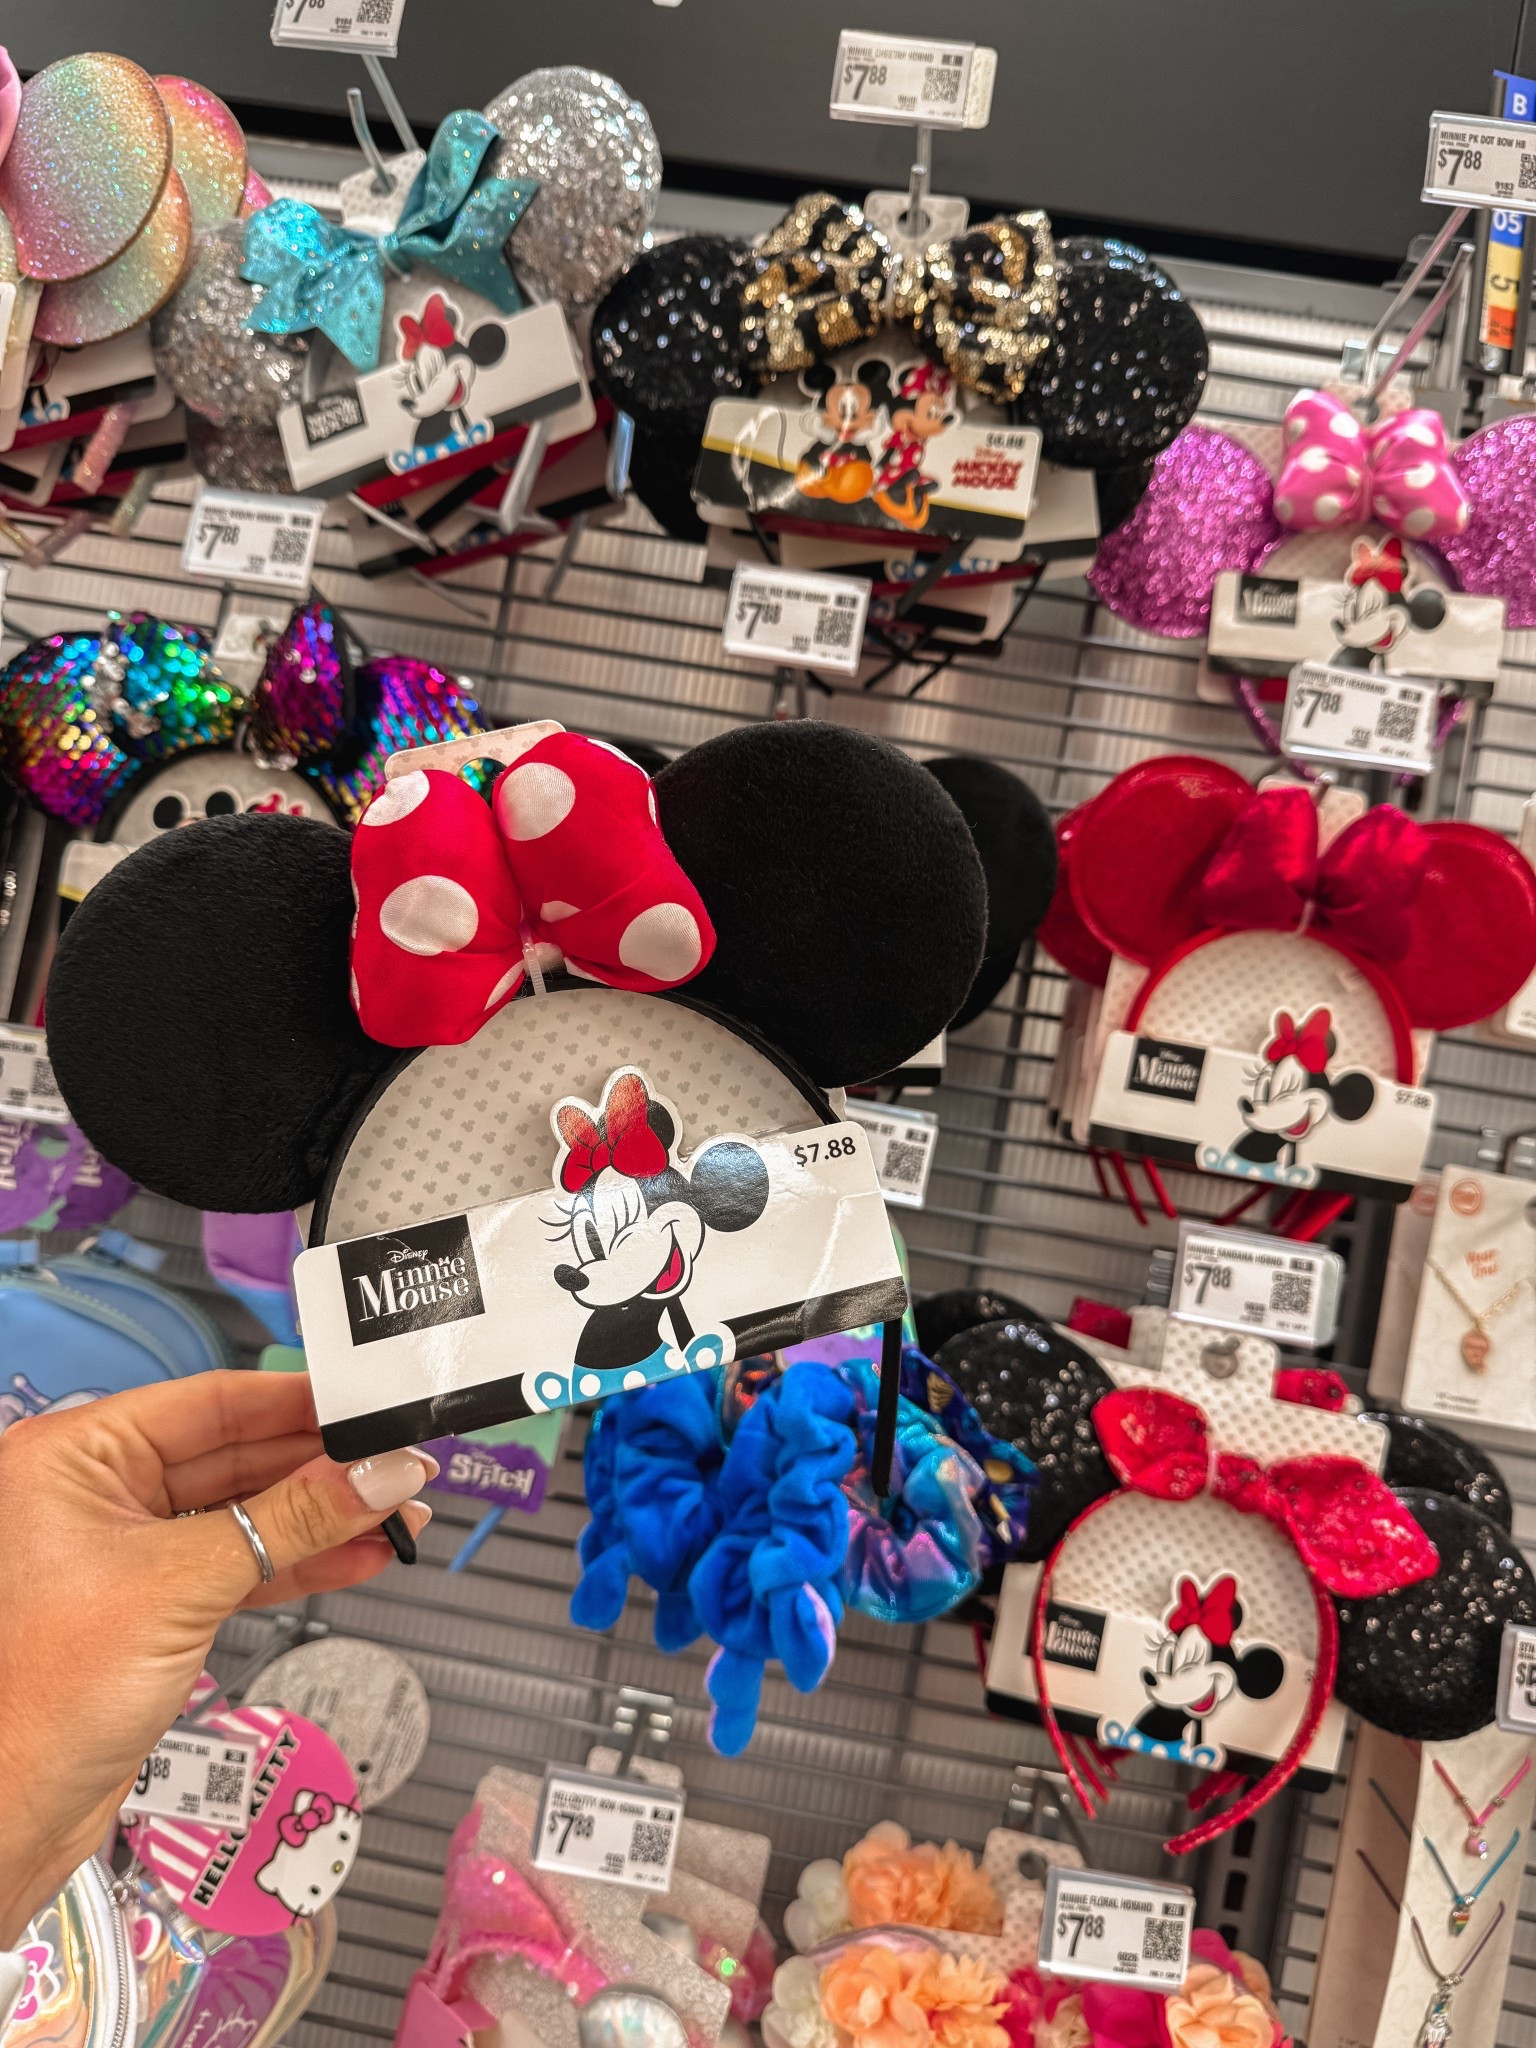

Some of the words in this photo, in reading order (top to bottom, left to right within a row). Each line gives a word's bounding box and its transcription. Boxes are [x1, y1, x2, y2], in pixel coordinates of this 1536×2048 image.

[1512, 92, 1528, 116] B
[1441, 131, 1466, 142] MINNIE
[1468, 134, 1478, 143] PK
[1480, 135, 1495, 145] DOT
[1497, 137, 1514, 148] BOW
[794, 1136, 856, 1167] $7.88
[353, 1257, 466, 1322] Minnie
[250, 1733, 296, 1817] KITTY
